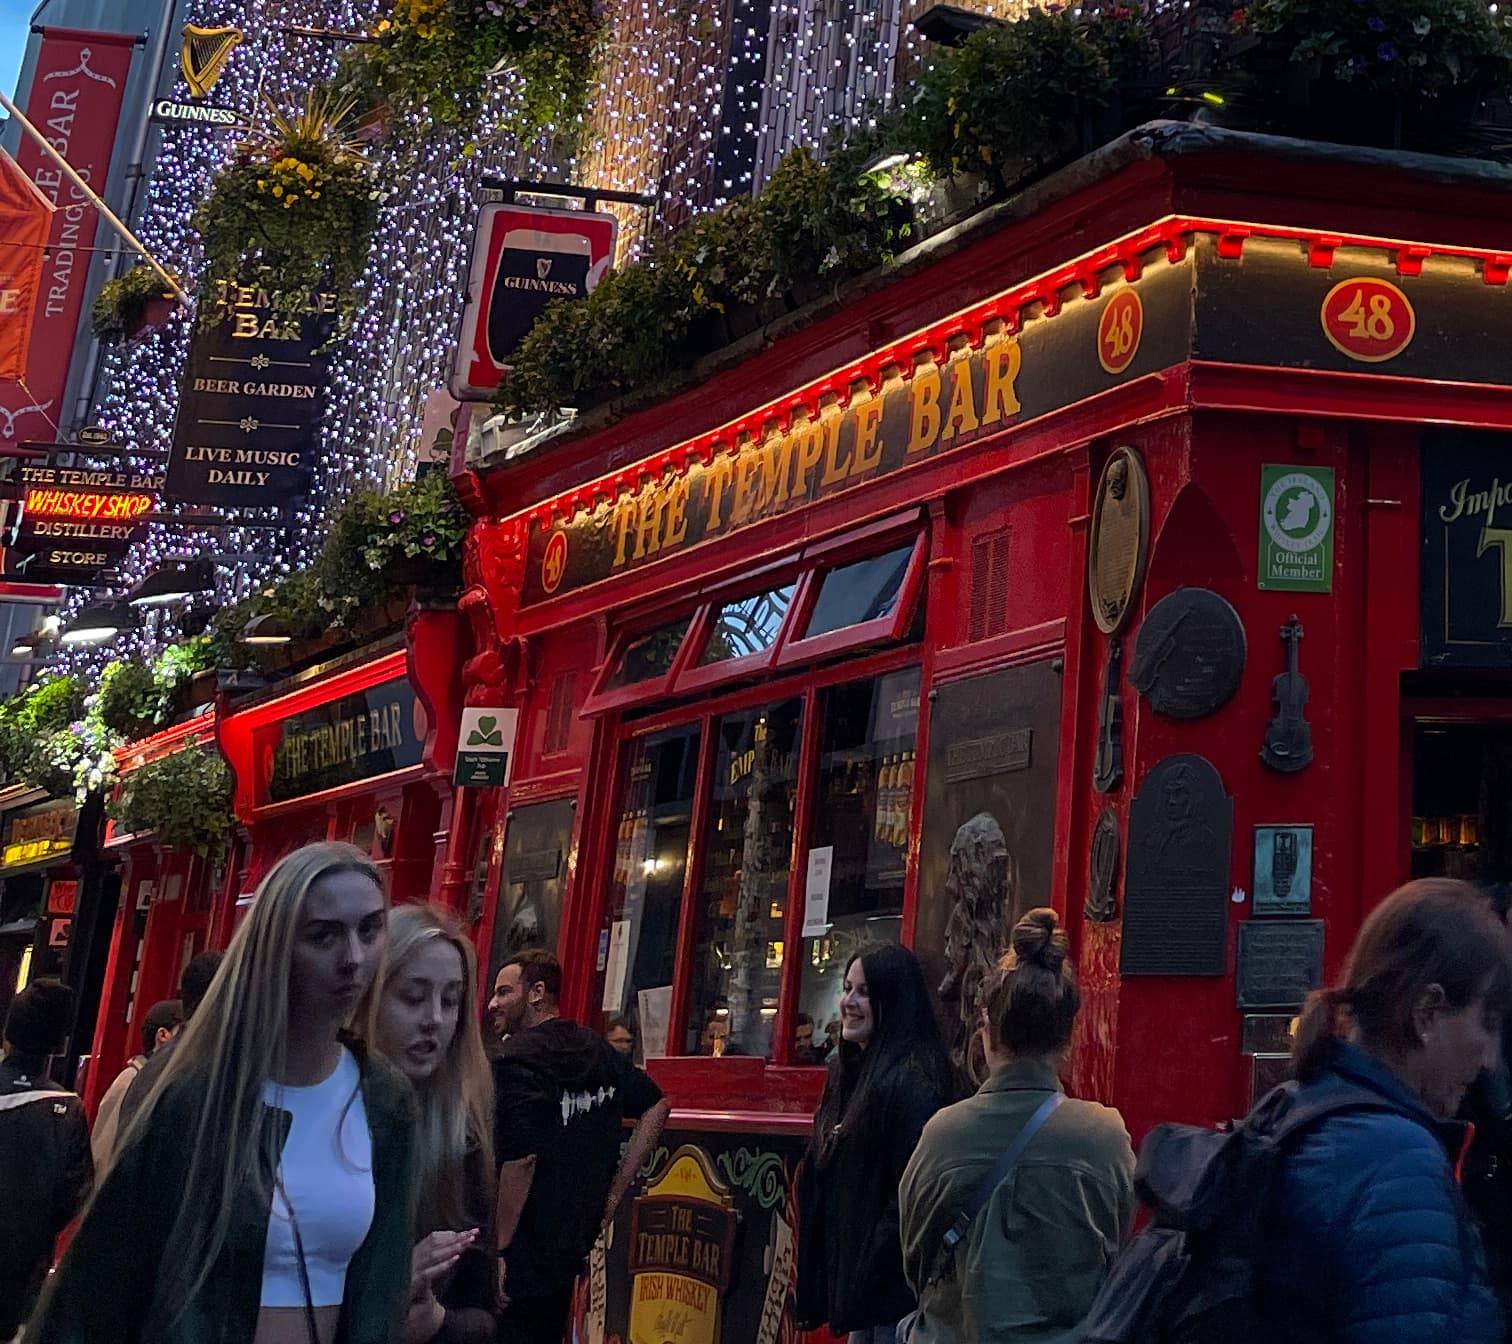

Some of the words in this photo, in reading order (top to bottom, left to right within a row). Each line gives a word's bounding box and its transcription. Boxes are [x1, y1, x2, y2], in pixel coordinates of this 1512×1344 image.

[156, 100, 236, 124] GUINNESS
[45, 202, 84, 318] TRADING
[503, 276, 578, 295] GUINNESS
[1339, 289, 1395, 343] 48
[1107, 303, 1136, 357] 48
[192, 378, 240, 395] BEER
[242, 381, 317, 399] GARDEN
[184, 446, 232, 463] LIVE
[234, 448, 300, 467] MUSIC
[610, 486, 690, 567] THE
[702, 401, 886, 532] TEMPLE
[907, 340, 1023, 452] BAR
[21, 467, 57, 483] THE
[60, 470, 128, 488] TEMPLE
[130, 474, 166, 490] BAR
[207, 469, 270, 487] DAILY
[26, 488, 107, 518] WHISKEY
[104, 494, 153, 519] SHOP
[33, 521, 136, 540] DISTILLERY
[49, 550, 108, 566] STORE
[1275, 551, 1318, 566] Official
[1271, 565, 1321, 579] Member
[280, 732, 309, 781] THE
[307, 710, 368, 772] TEMPLE
[369, 701, 403, 752] BAR
[671, 1205, 694, 1234] THE
[638, 1232, 690, 1267] TEMPLE
[692, 1240, 721, 1277] BAR
[639, 1274, 664, 1303] IRISH
[665, 1277, 712, 1315] WHISKEY
